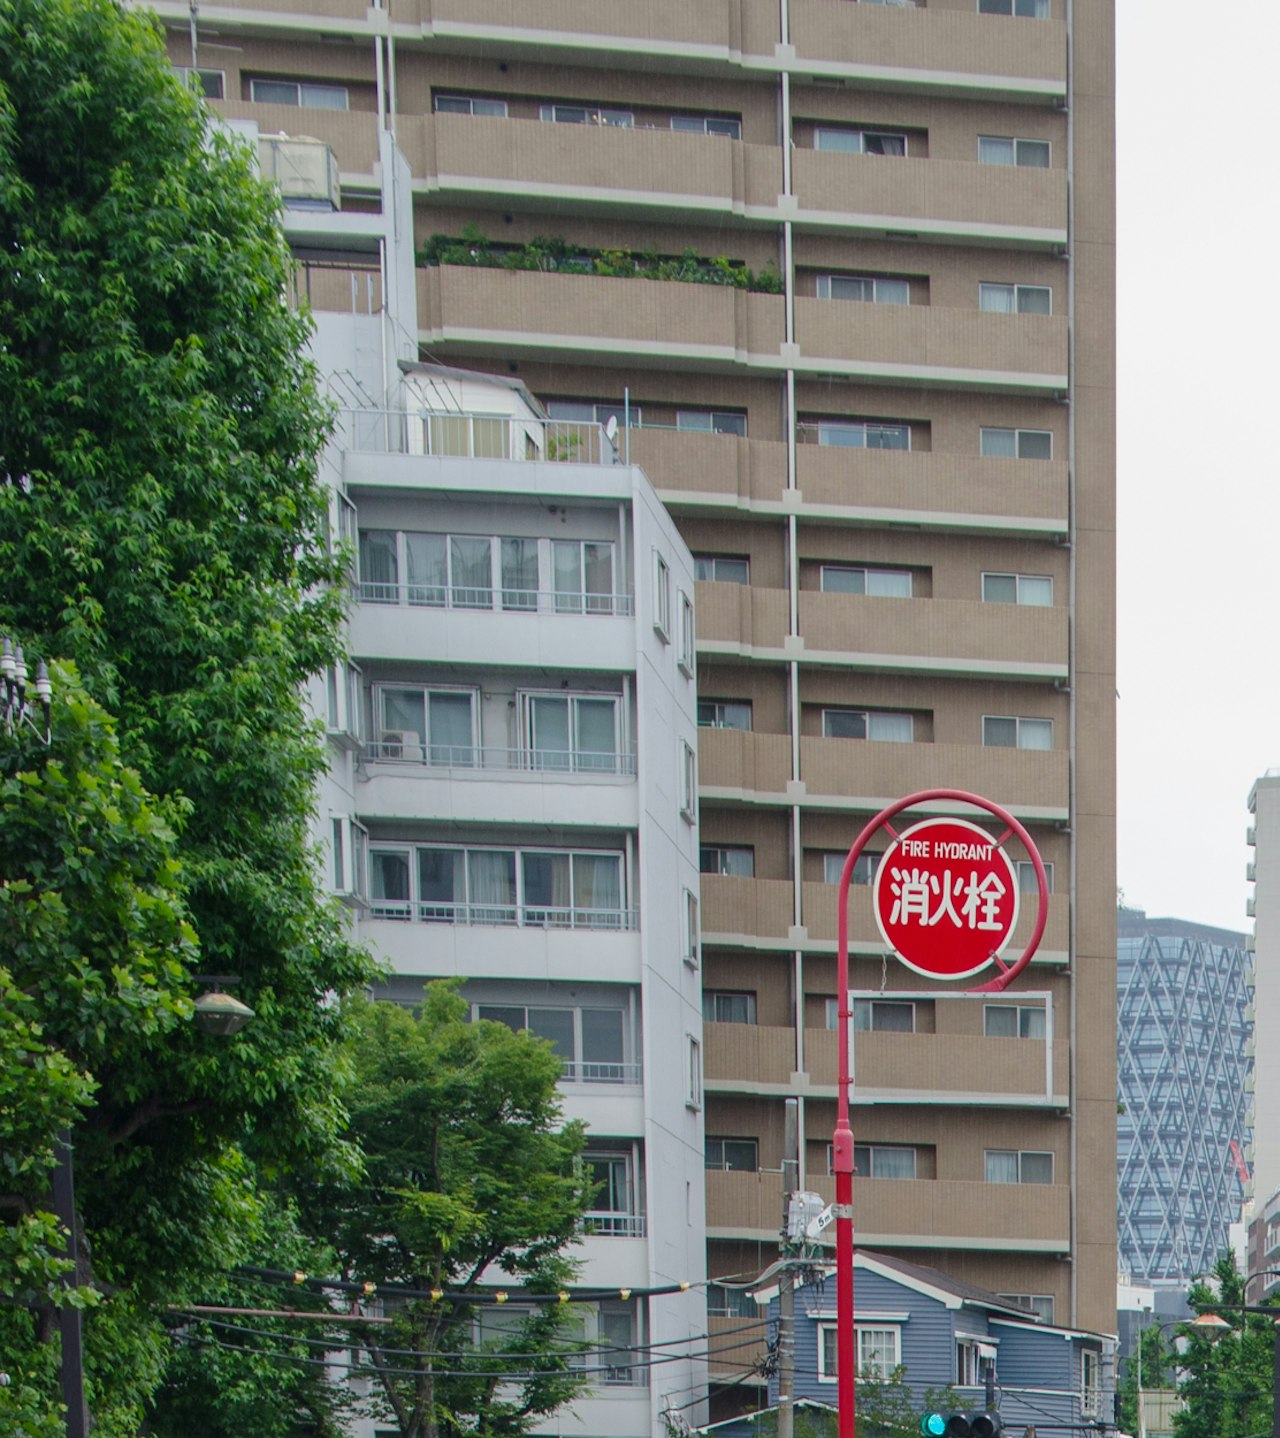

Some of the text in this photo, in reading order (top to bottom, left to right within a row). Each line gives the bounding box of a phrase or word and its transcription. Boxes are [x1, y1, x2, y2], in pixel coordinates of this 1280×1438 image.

[901, 840, 994, 861] FIRE HYDRANT
[889, 867, 1006, 931] 消火栓
